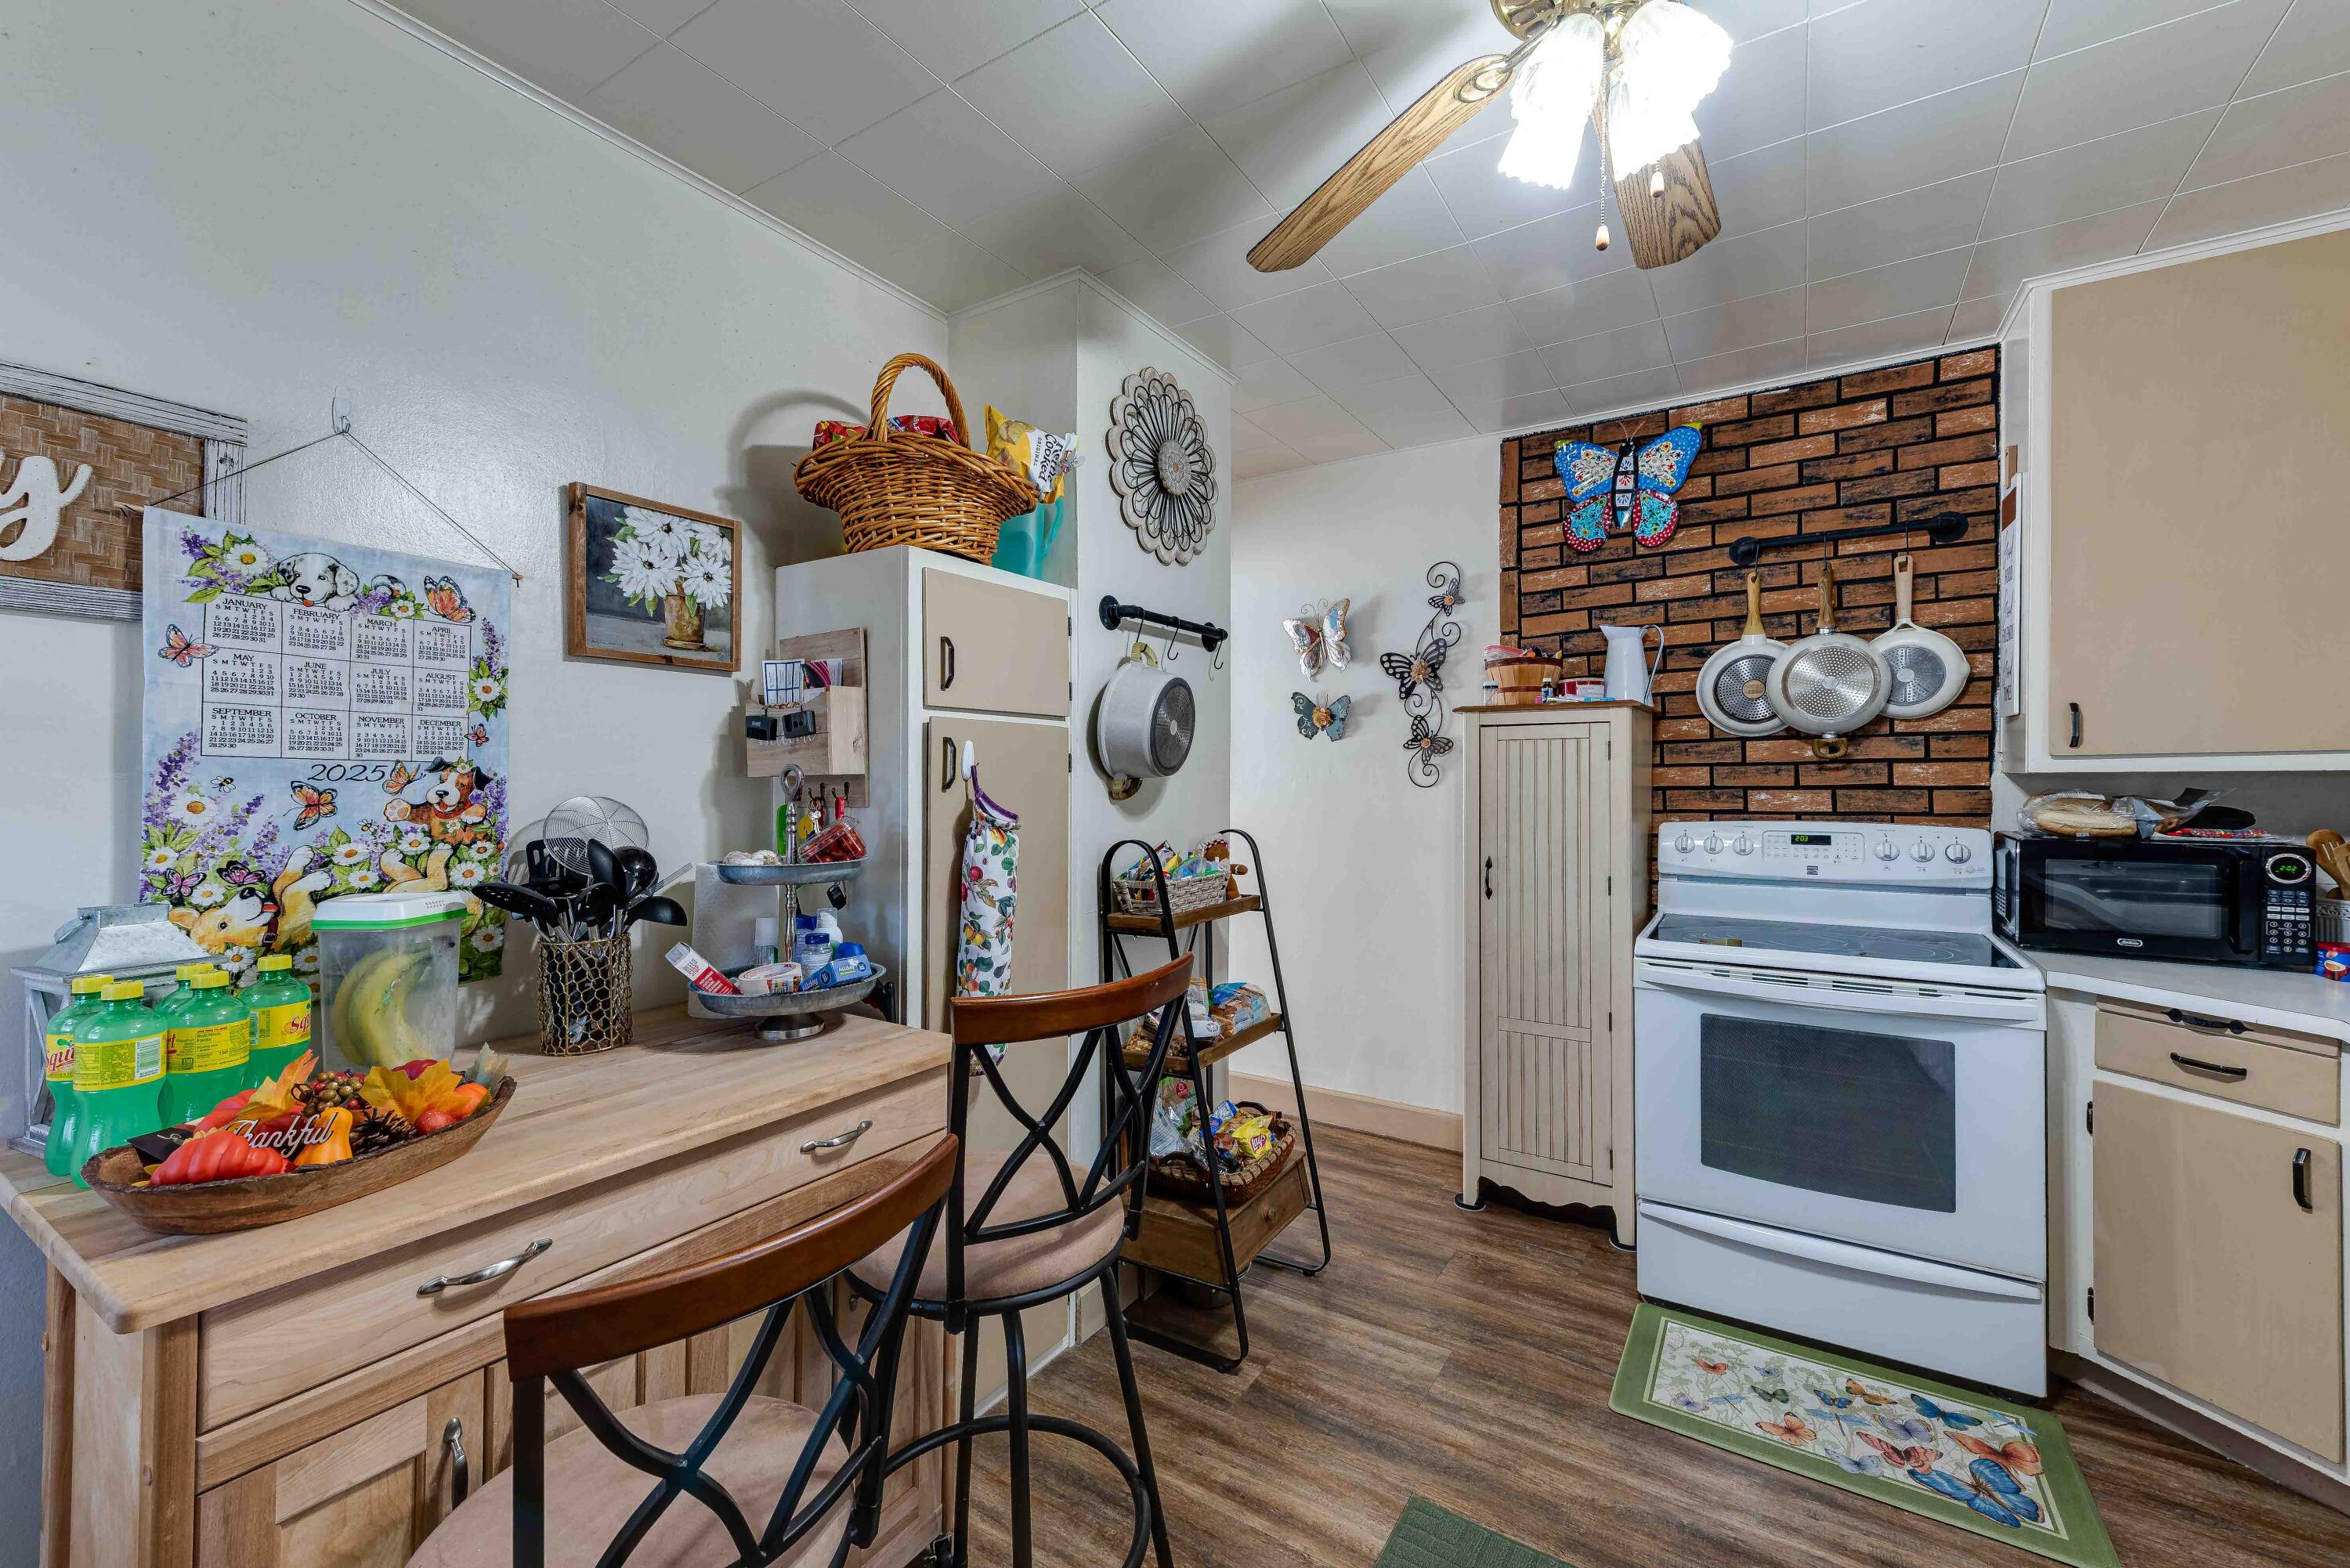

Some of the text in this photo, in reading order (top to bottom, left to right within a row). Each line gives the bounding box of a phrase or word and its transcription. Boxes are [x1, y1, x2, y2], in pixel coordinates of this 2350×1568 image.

[1034, 436, 1042, 466] ORIGINAL
[1039, 434, 1058, 482] Cooked
[222, 598, 268, 610] JANUARY
[293, 608, 340, 620] FEBRUARY
[367, 618, 396, 627] MARCH
[212, 708, 272, 717] SEPTEMBER
[307, 764, 389, 782] 2025
[682, 958, 696, 974] BLEED
[689, 965, 700, 977] STOP
[226, 1112, 338, 1158] Thankful
